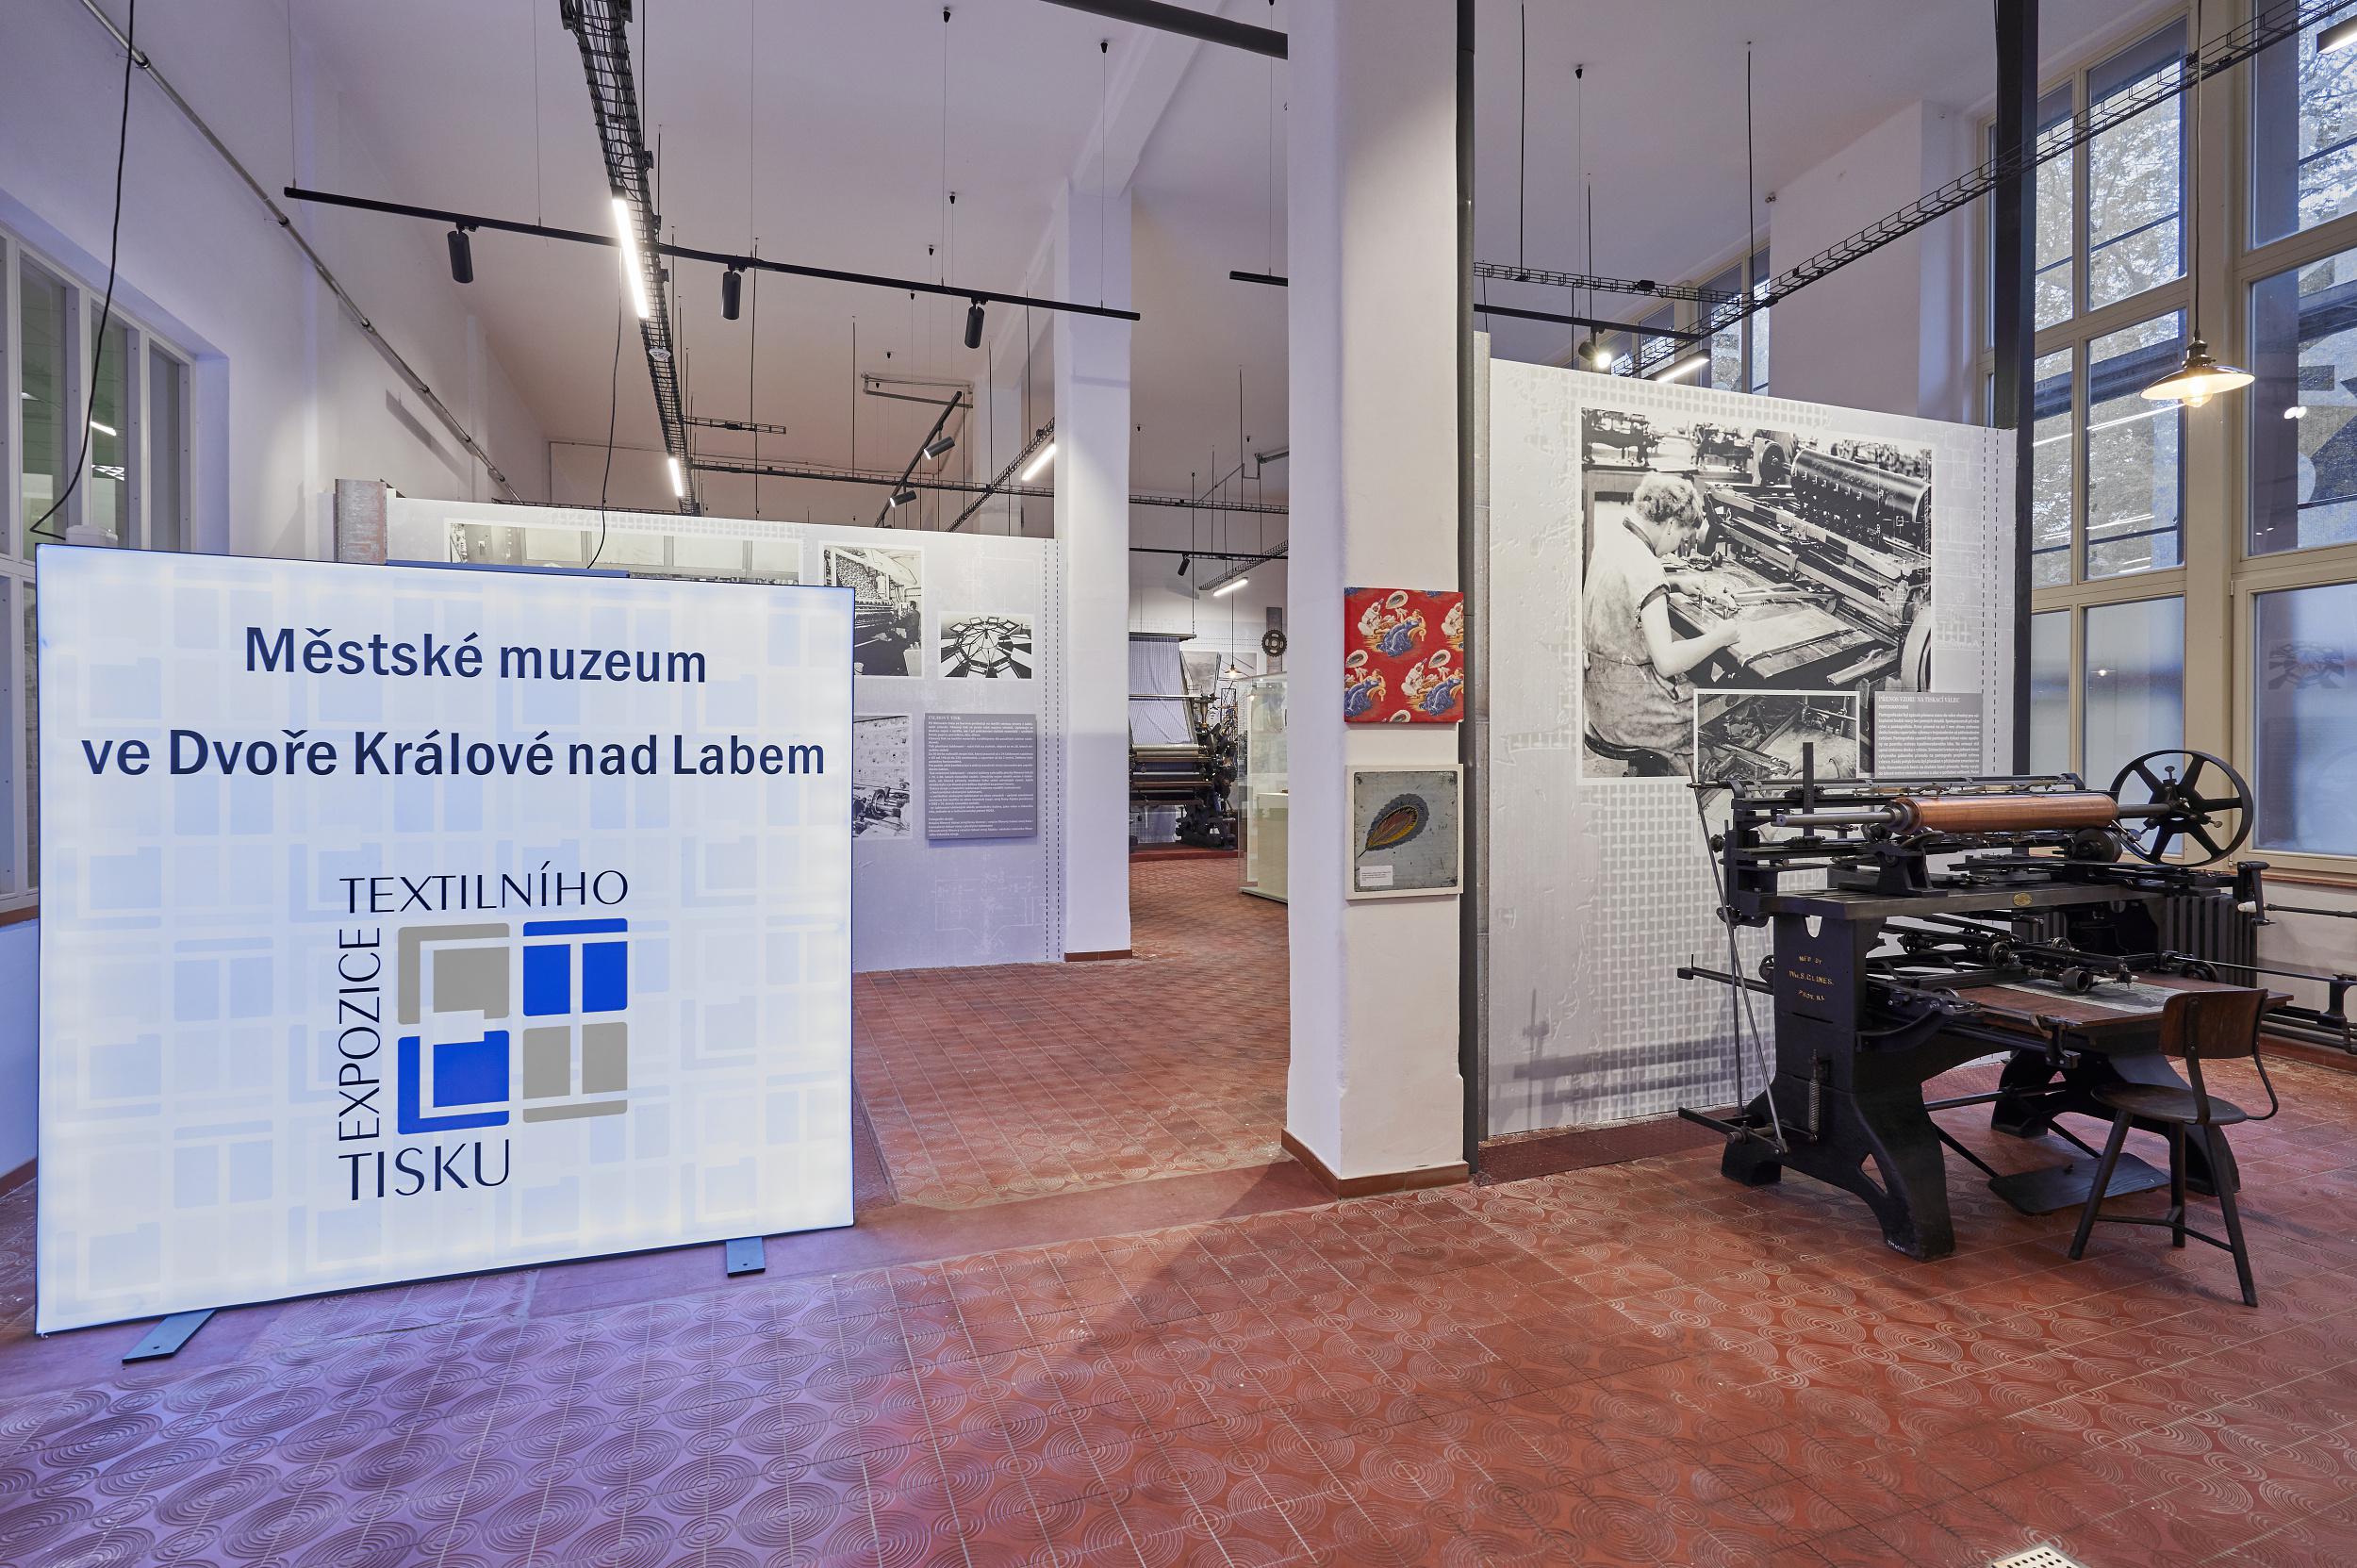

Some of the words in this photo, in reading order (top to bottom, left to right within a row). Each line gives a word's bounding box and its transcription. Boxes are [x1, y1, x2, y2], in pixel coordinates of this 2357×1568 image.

[247, 627, 482, 677] Městské
[501, 647, 704, 683] muzeum
[82, 740, 149, 775] ve
[171, 730, 337, 775] Dvoře
[355, 729, 553, 775] Králové
[569, 734, 656, 775] nad
[675, 734, 823, 775] Labem
[339, 861, 628, 914] TEXTILNÍHO
[338, 928, 380, 1141] EXPOZICE
[339, 1138, 509, 1200] TISKU
